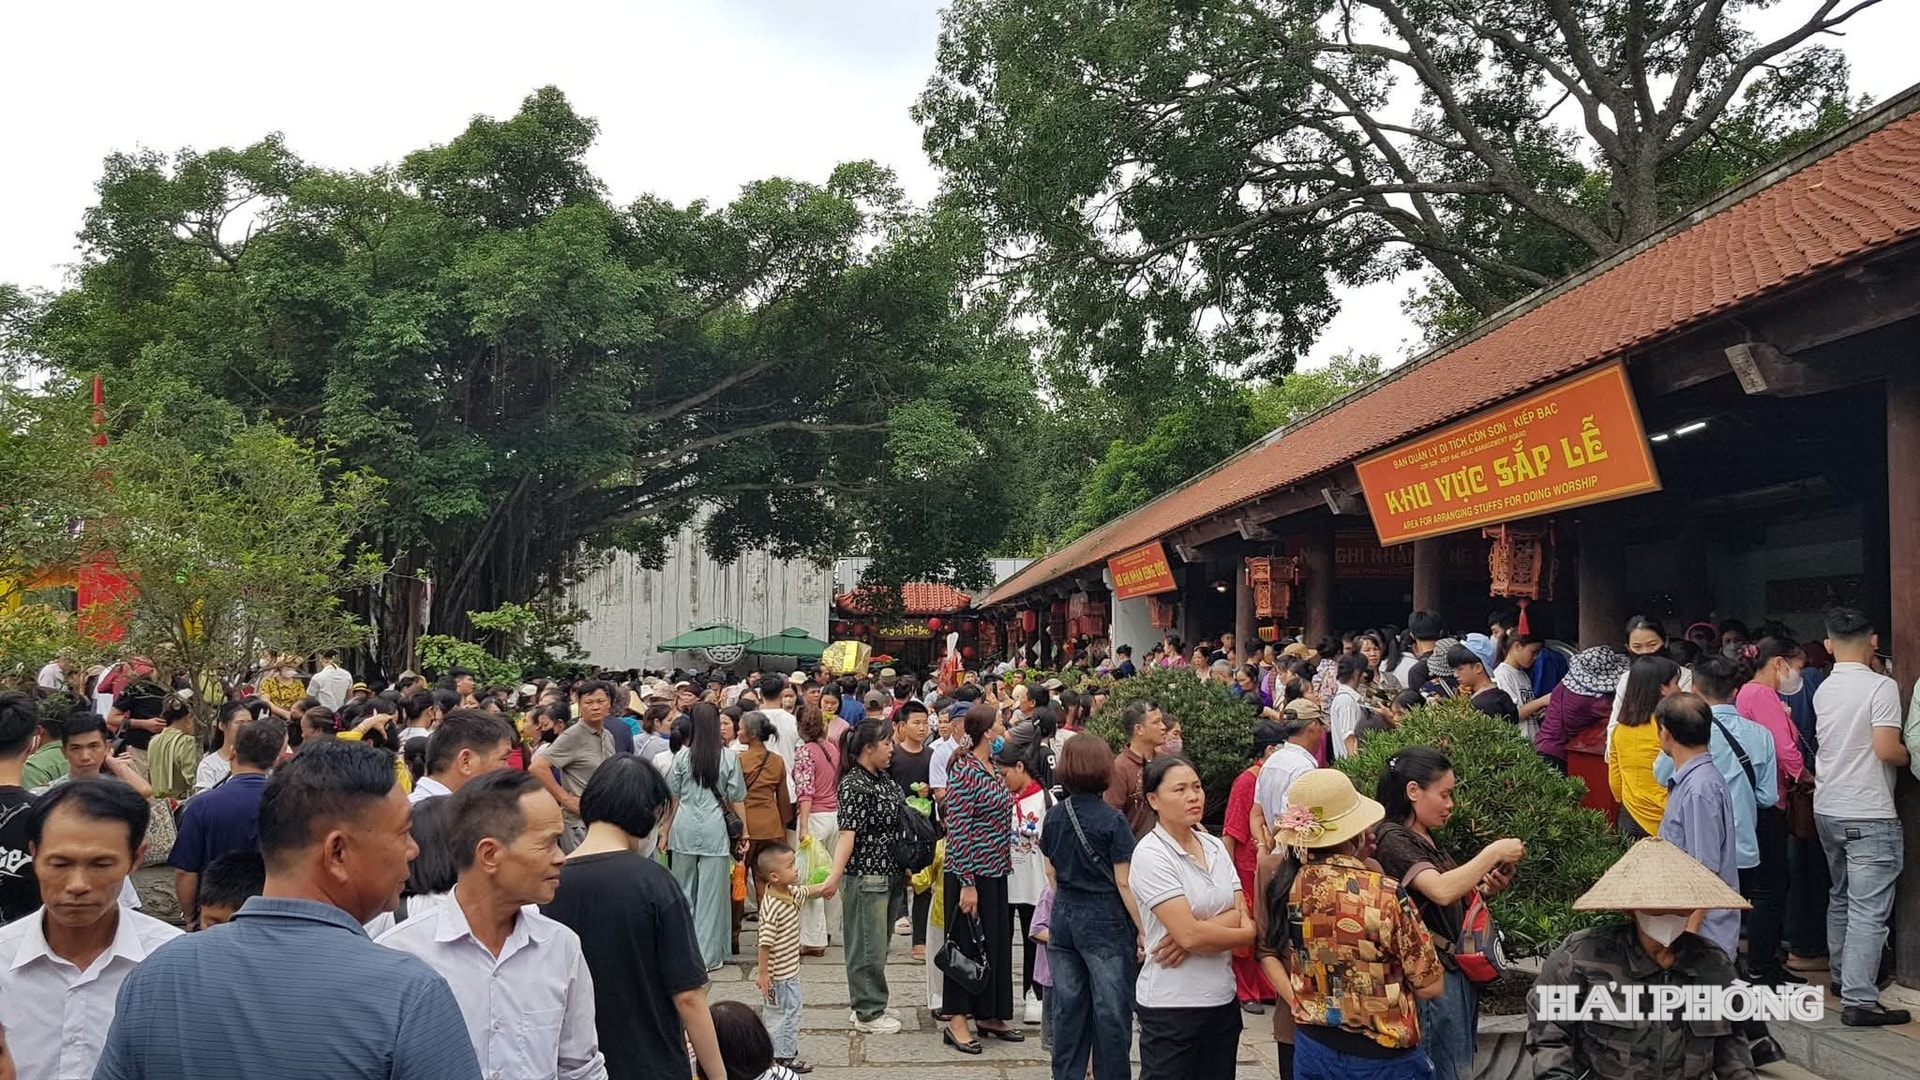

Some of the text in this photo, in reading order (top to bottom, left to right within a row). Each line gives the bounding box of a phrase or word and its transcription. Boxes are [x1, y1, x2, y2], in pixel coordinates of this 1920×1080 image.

[1384, 413, 1608, 515] KHU VỰC SẮP LỄ
[1393, 457, 1408, 470] BAN
[1408, 449, 1428, 465] QUẢN
[1427, 443, 1438, 458] LÝ
[1440, 443, 1449, 454] DI
[1449, 435, 1468, 452] TÍCH
[1468, 429, 1487, 444] CÔN
[1487, 421, 1508, 437] SƠN
[1513, 409, 1536, 429] KIẾP
[1537, 402, 1559, 420] BẠC
[1474, 438, 1508, 455] MANAGEMENT
[1508, 429, 1527, 441] BOARD
[1403, 474, 1599, 531] AREA FOR ARRANGING STUFFS FOR DOING WORSHIP
[1047, 755, 1056, 769] 9
